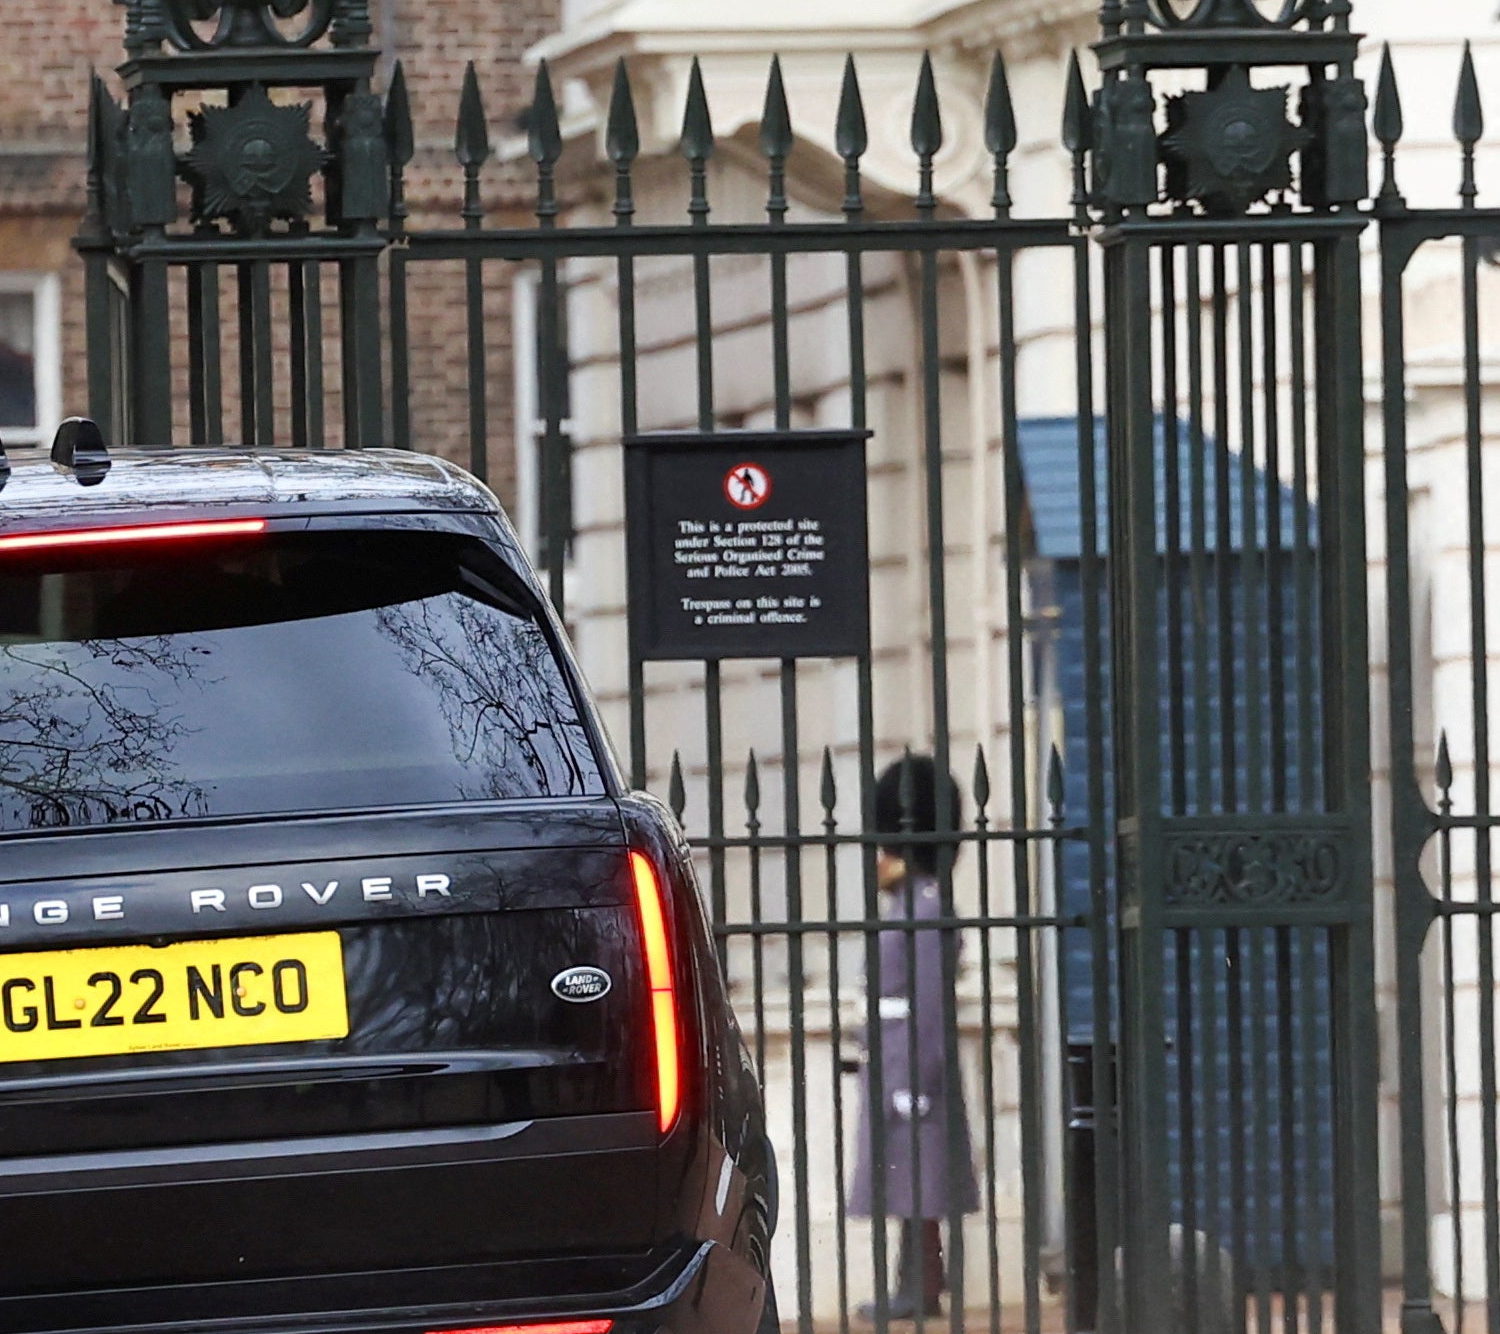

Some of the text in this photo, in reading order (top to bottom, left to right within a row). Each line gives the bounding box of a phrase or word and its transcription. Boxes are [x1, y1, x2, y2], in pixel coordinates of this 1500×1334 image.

[678, 519, 819, 537] This is a protected site
[675, 537, 709, 549] under
[713, 535, 757, 547] Section
[786, 534, 801, 545] of
[803, 533, 824, 545] the
[674, 547, 825, 564] Serious Organised Crime
[686, 565, 710, 578] and
[714, 565, 750, 577] Police
[754, 564, 777, 577] Act
[681, 595, 821, 611] Trespass on this site is
[707, 612, 756, 624] criminal
[190, 873, 452, 913] ROVER
[565, 974, 592, 986] LAND
[2, 959, 309, 1033] GL22 NCO
[568, 983, 601, 995] ROVER
